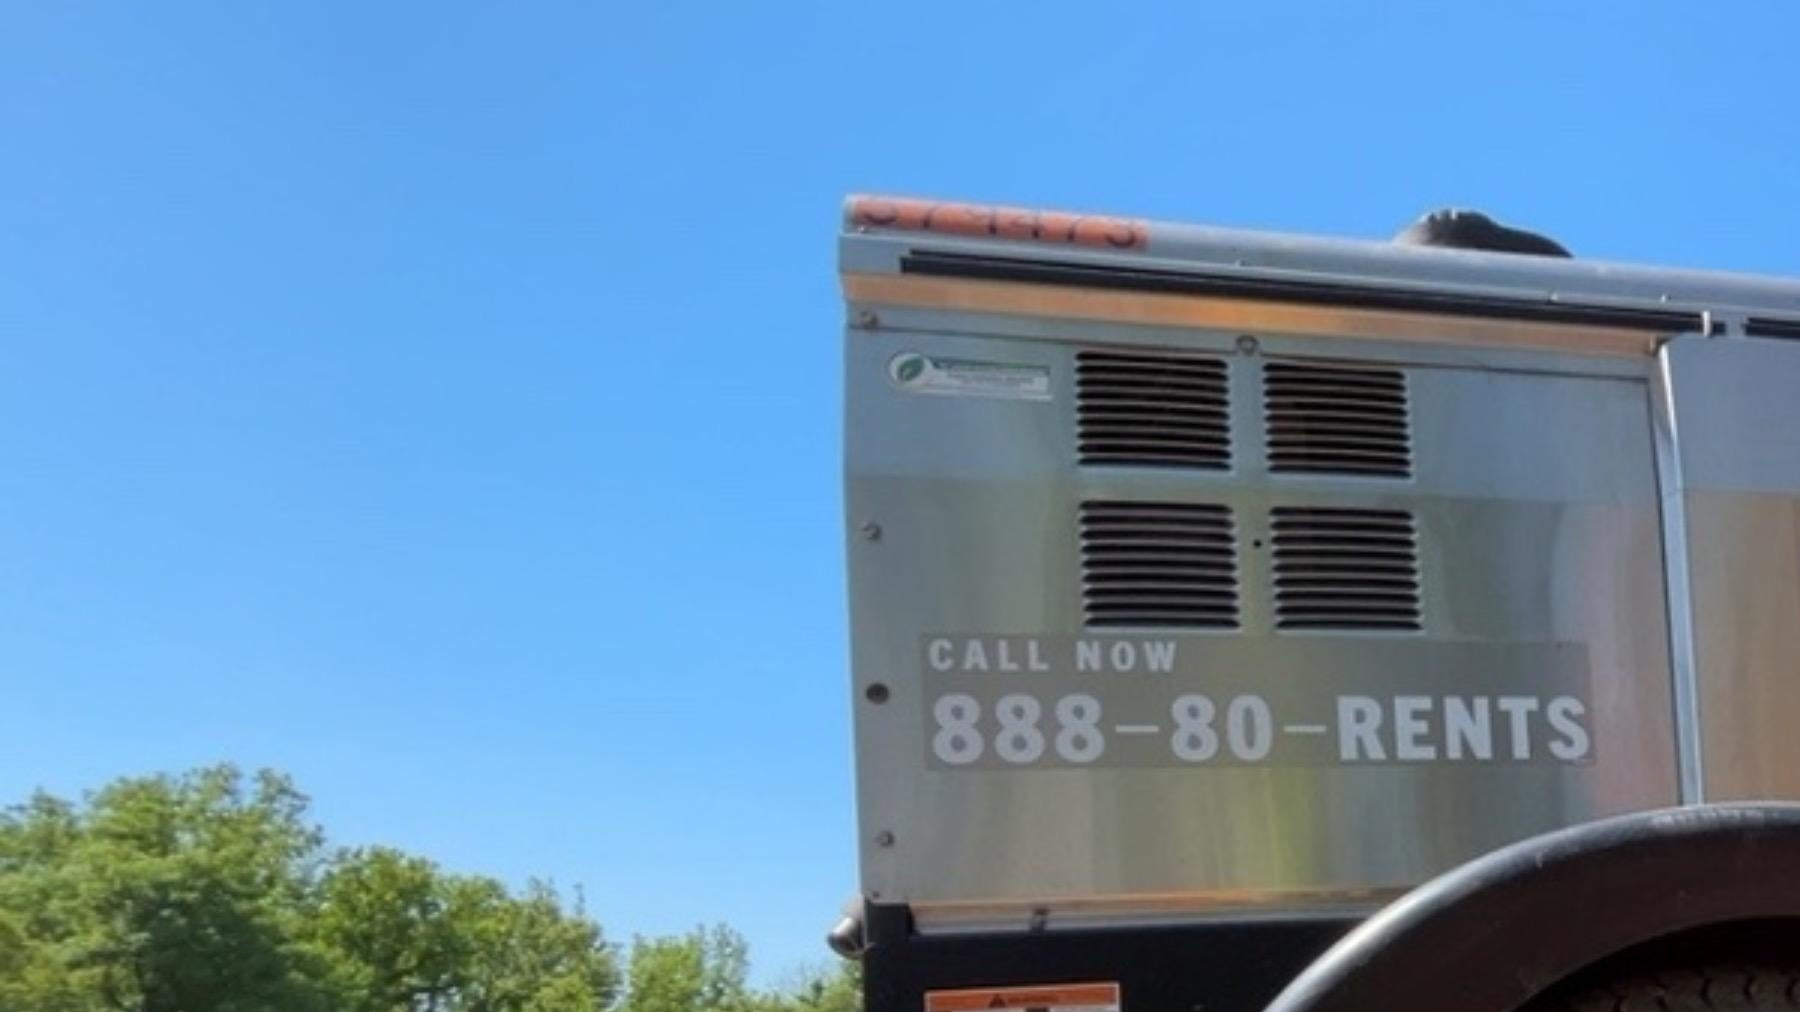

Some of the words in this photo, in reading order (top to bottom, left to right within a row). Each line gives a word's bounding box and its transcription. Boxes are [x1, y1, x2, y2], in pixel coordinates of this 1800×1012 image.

[928, 638, 1050, 672] CALL
[1075, 638, 1179, 672] NOW
[932, 693, 1590, 765] 888-80-RENTS
